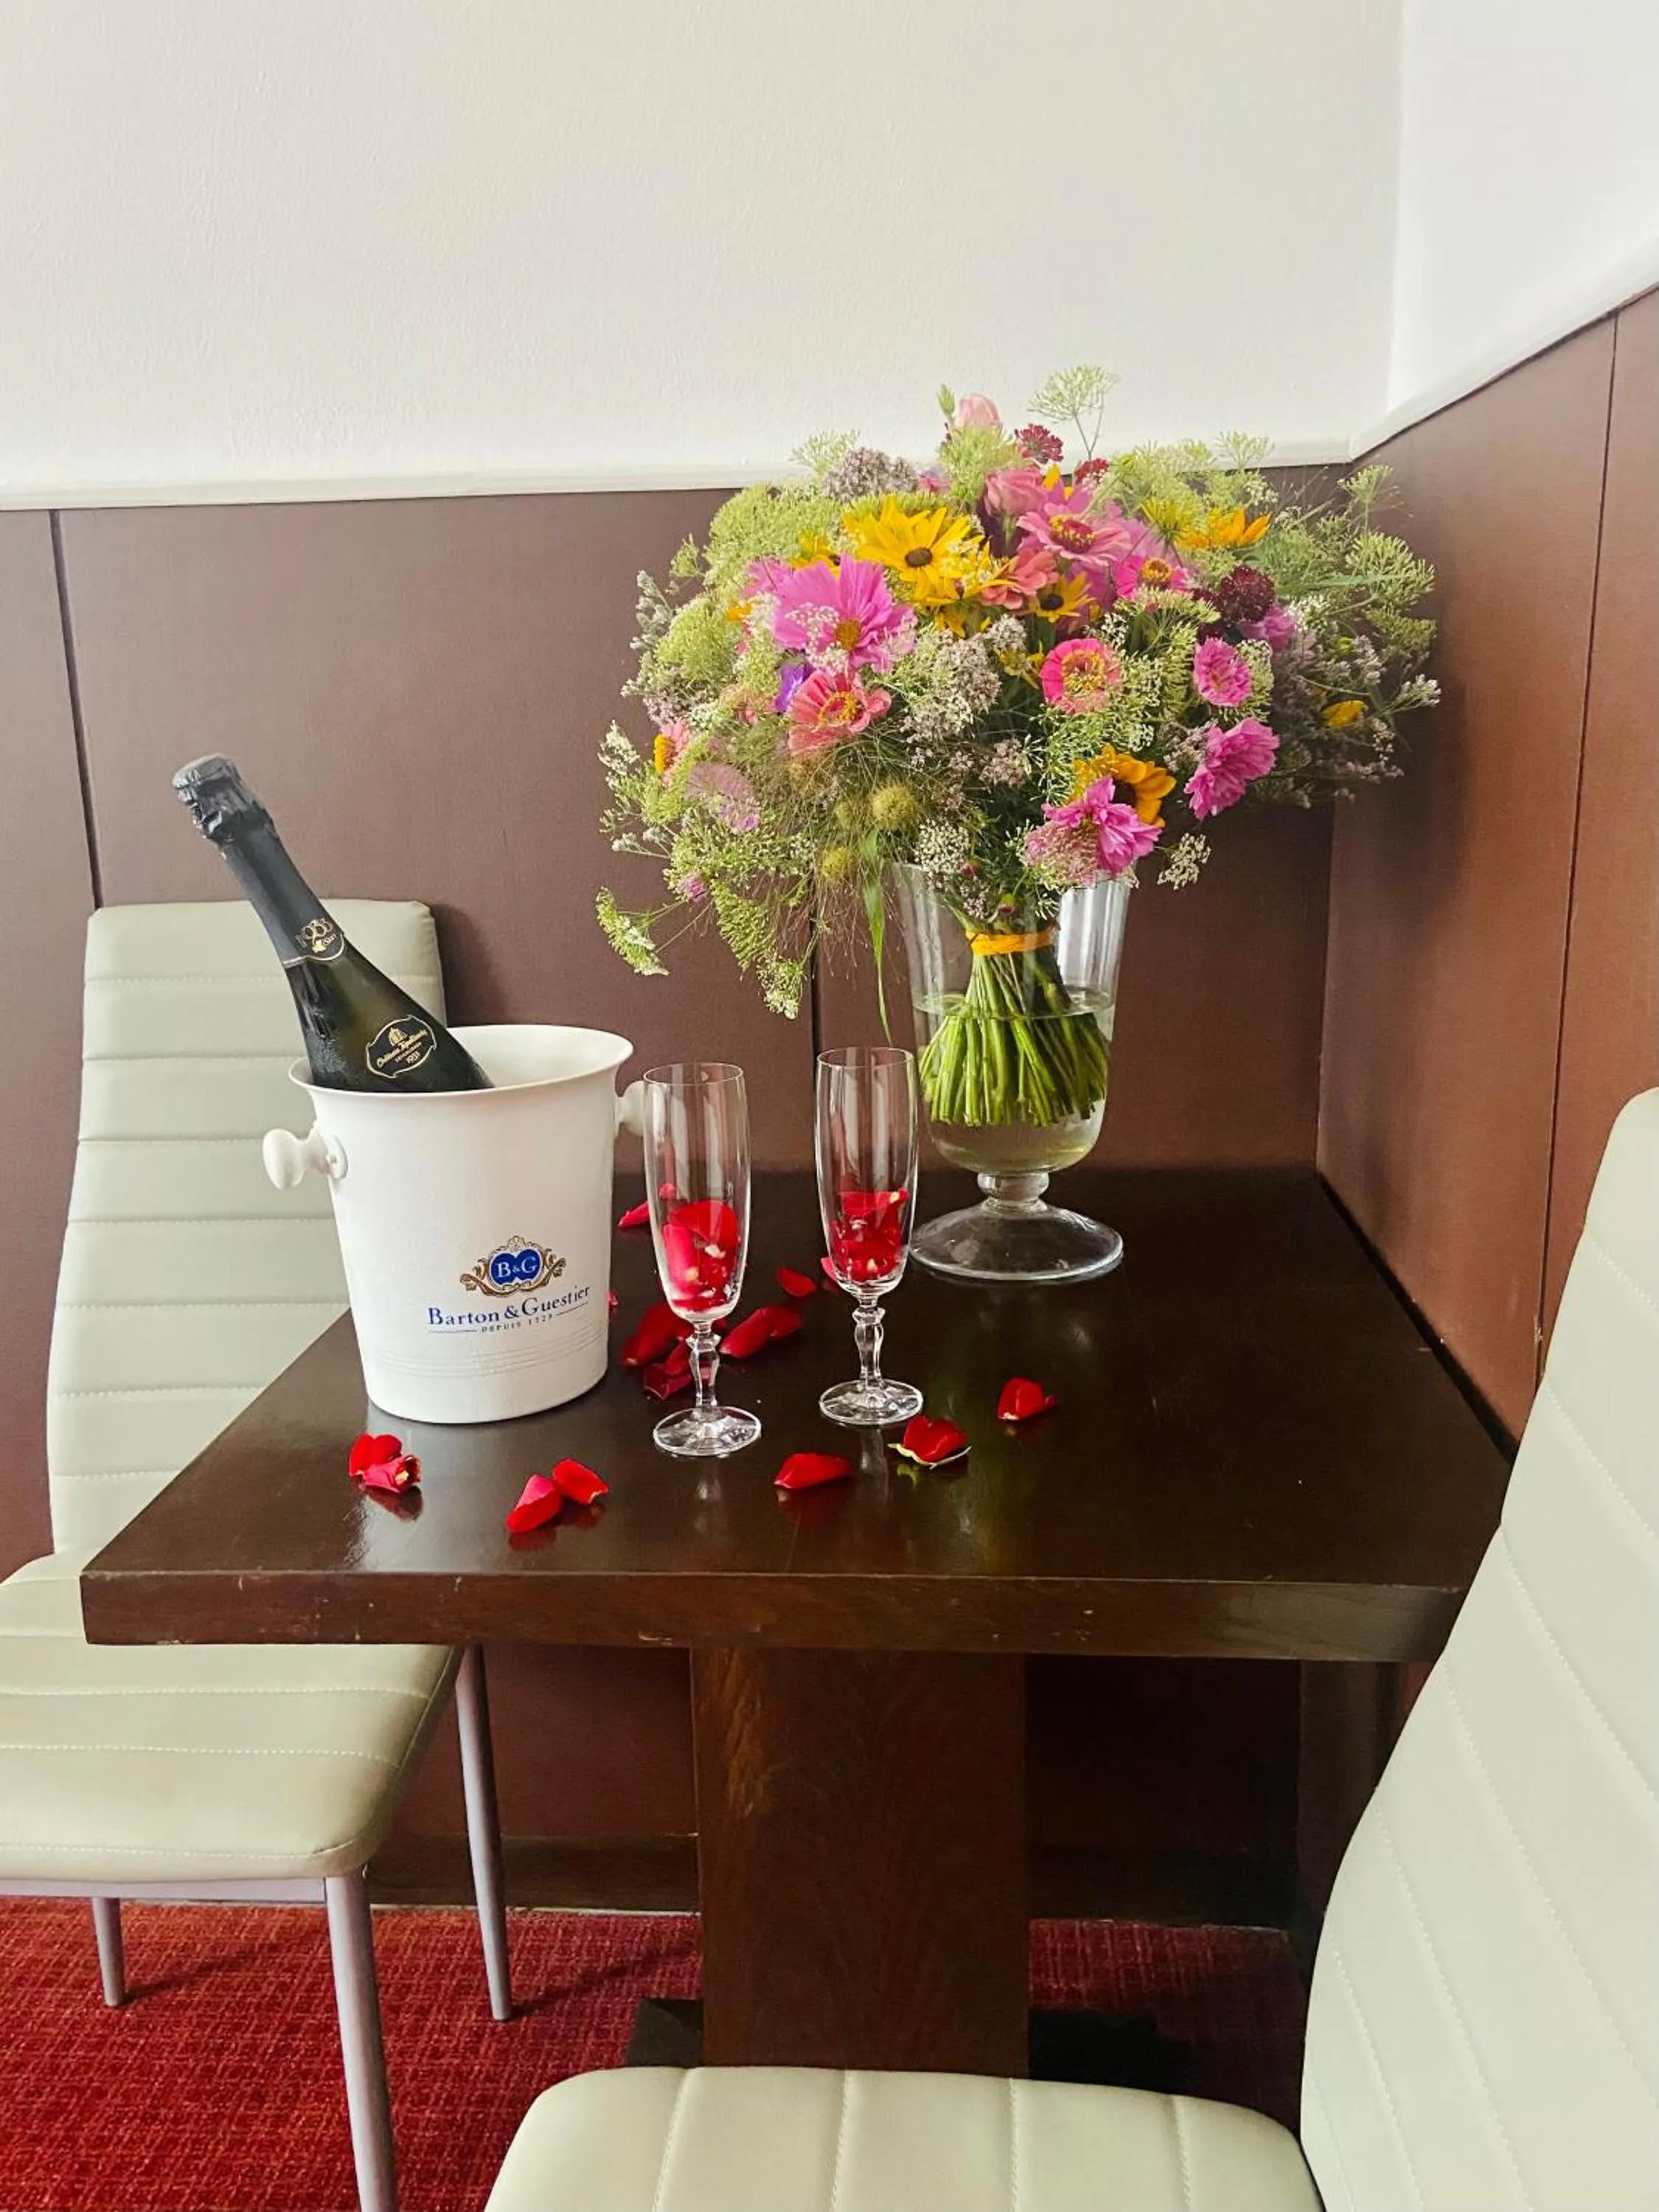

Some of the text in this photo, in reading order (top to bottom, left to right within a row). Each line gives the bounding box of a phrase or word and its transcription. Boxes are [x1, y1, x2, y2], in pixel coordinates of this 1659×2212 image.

[497, 1256, 538, 1278] B&G
[428, 1286, 591, 1326] Barton & Guestier
